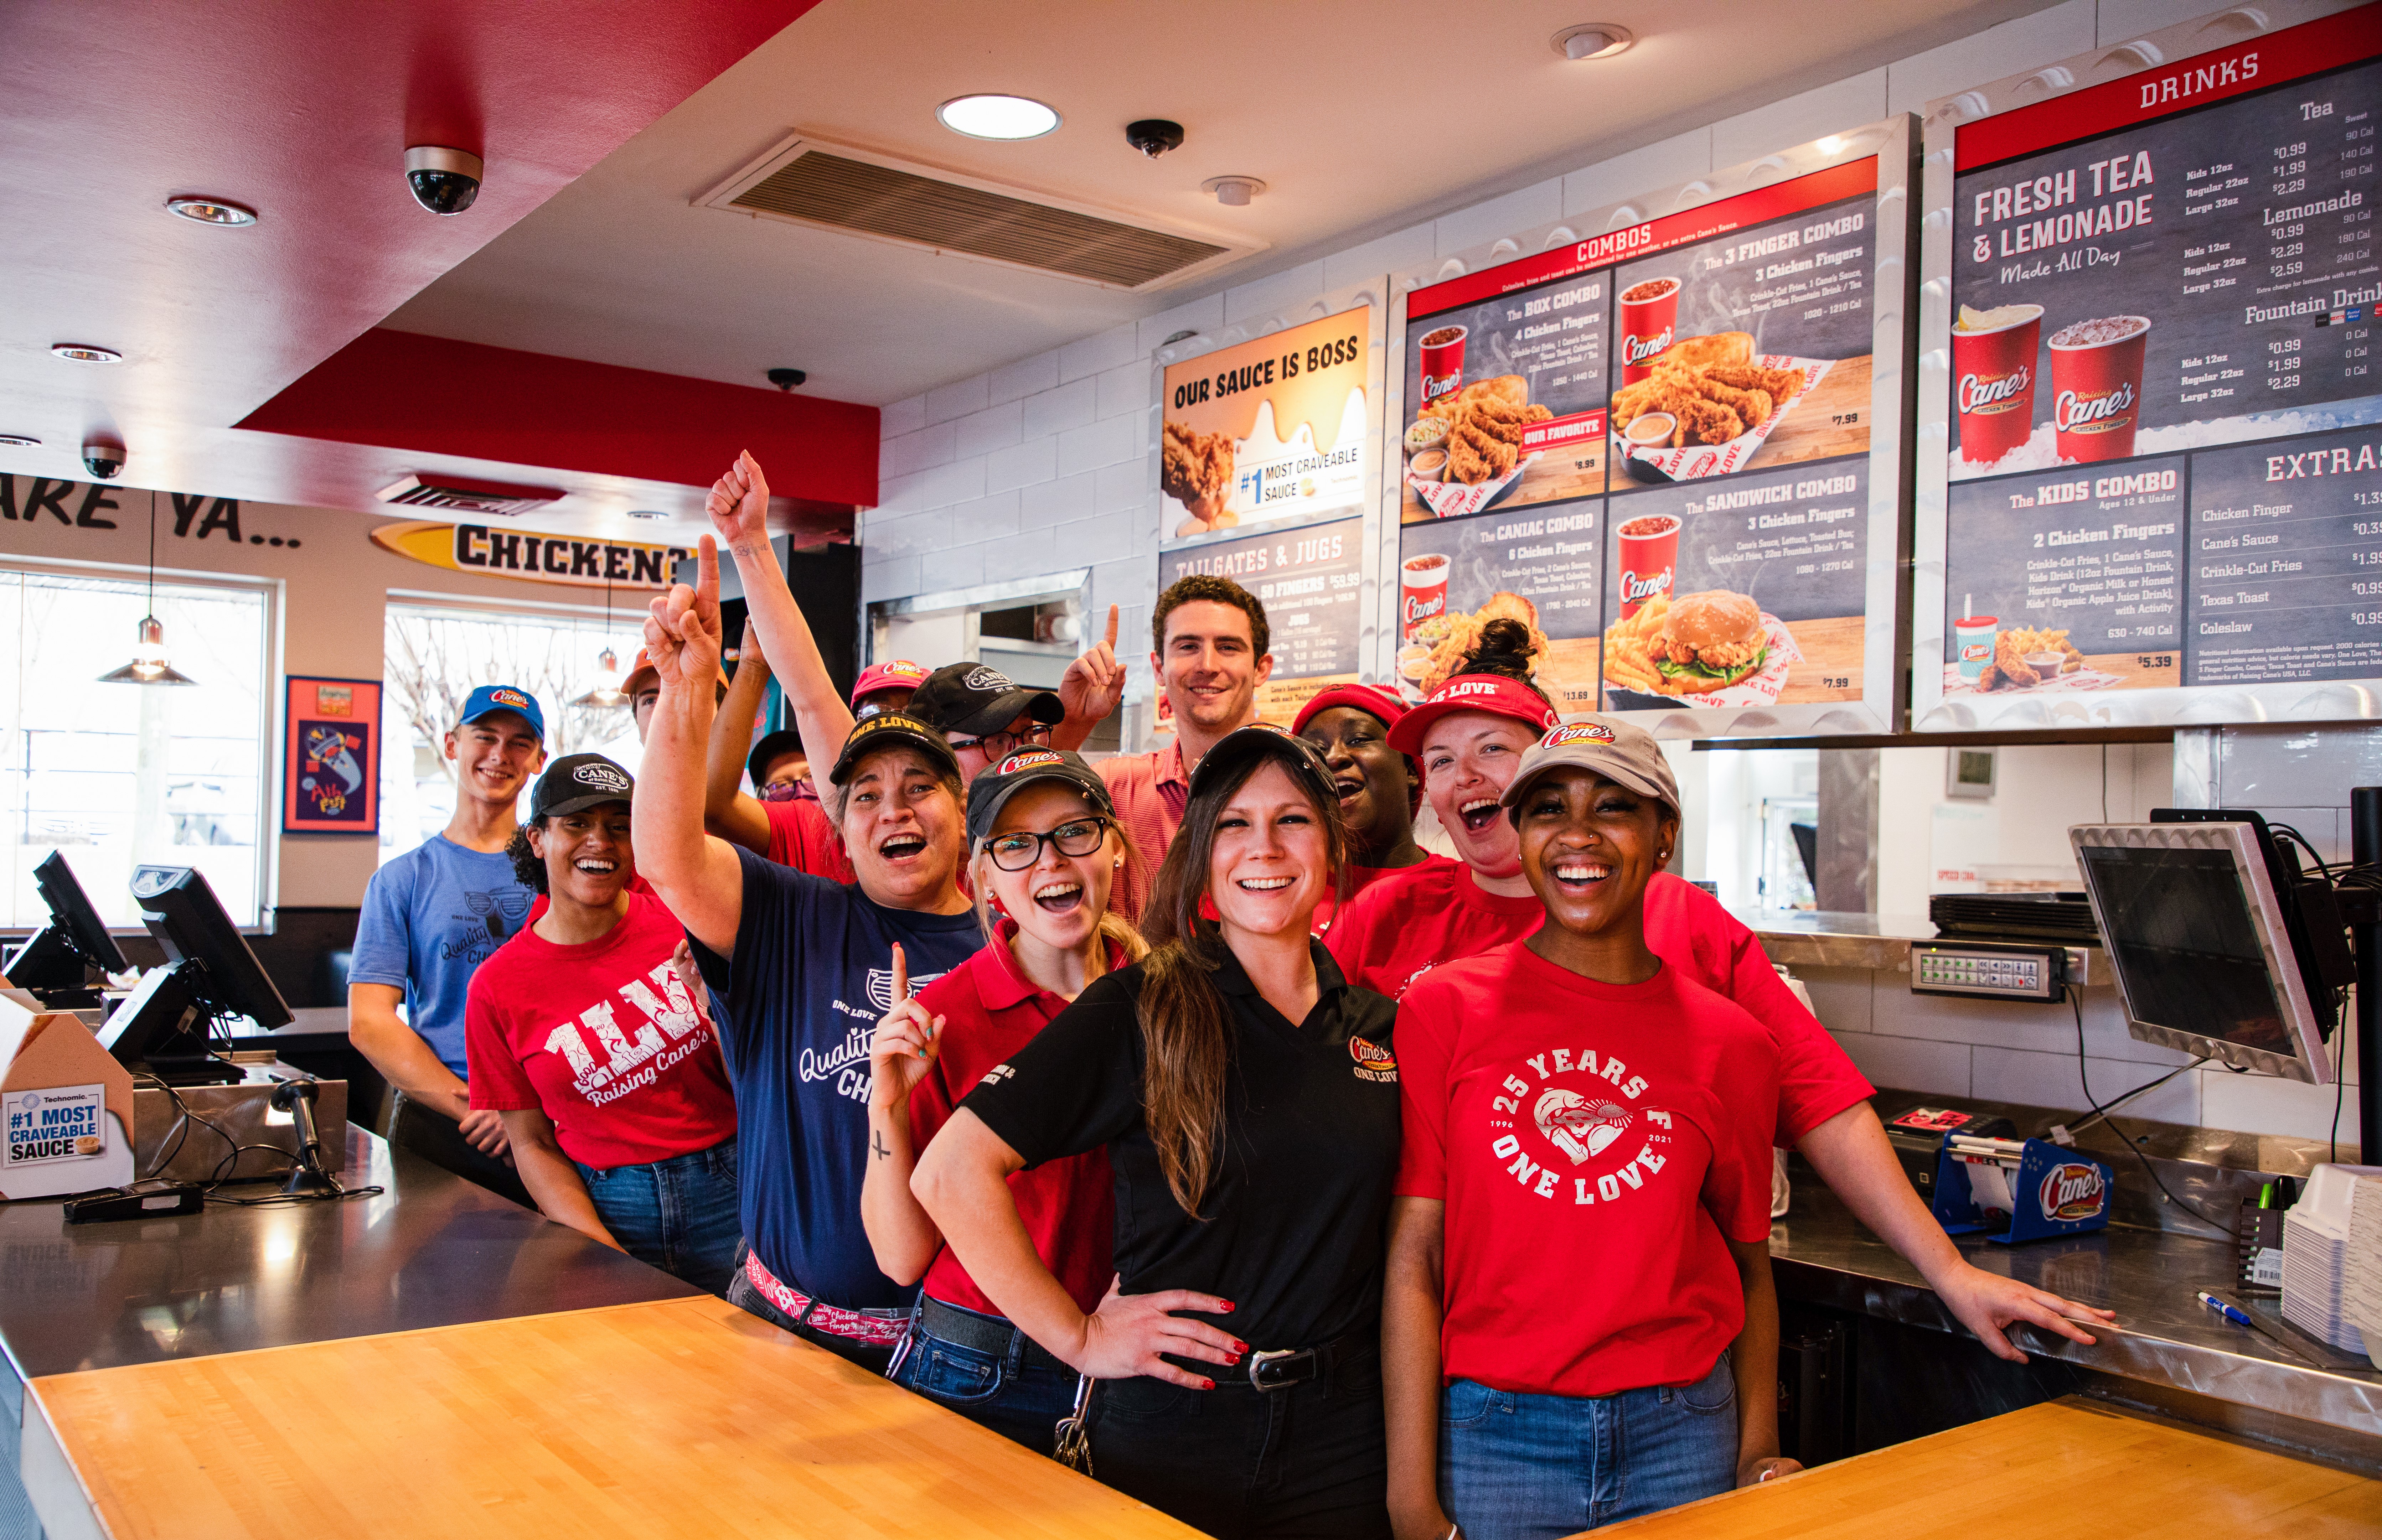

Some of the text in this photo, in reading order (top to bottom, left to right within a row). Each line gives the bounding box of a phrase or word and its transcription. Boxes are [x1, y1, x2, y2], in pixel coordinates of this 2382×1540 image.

[2140, 52, 2258, 108] DRINKS
[2300, 102, 2334, 121] Tea
[2345, 112, 2367, 123] Sweet
[2274, 142, 2307, 159] $0.99
[2186, 161, 2306, 181] Kids 12oz $1.99
[1975, 150, 2154, 226] FRESH TEA
[2186, 177, 2305, 198] Regular 22oz $2.29
[2186, 197, 2238, 216] Large 32oz
[2263, 190, 2362, 226] Lemonade
[1973, 194, 2153, 263] & LEMONADE
[2272, 224, 2304, 240] $0.99
[1577, 224, 1651, 262] COMBOS
[1704, 213, 1864, 270] The 3 FINGER COMBO
[2184, 242, 2304, 259] Kids 12oz $2.29
[1756, 246, 1863, 282] 3 Chicken Fingers
[2001, 247, 2120, 284] Made All Day
[2183, 257, 2303, 278] Regular 22oz $2.59
[2183, 277, 2236, 295] Large 32oz
[2303, 275, 2330, 285] lemonade
[1507, 284, 1600, 321] The BOX COMBO
[2245, 297, 2326, 325] Fountain
[1515, 313, 1600, 341] 4 Chicken Fingers
[1623, 326, 1673, 366] Cane's
[2268, 339, 2301, 354] $0.99
[1175, 336, 1358, 409] OUR SAUCE IS BOSS
[2268, 357, 2301, 372] $1.99
[1422, 368, 1461, 402] Cane's
[1959, 365, 2030, 414] Cane's
[2268, 375, 2300, 390] $2.29
[2055, 382, 2135, 432] Cane's
[1832, 413, 1858, 426] $7.99
[1524, 420, 1599, 445] OUR FAVORITE
[1265, 447, 1357, 481] MOST CRAVEABLE
[1576, 459, 1595, 470] $8.99
[1241, 469, 1262, 504] #1
[1265, 482, 1296, 501] SAUCE
[1686, 475, 1857, 515] The SANDWICH COMBO
[2010, 470, 2176, 509] The KIDS COMBO
[2098, 500, 2121, 511] Ages
[2123, 498, 2134, 506] 12
[2149, 493, 2176, 503] Under
[2202, 503, 2293, 522] Chicken Finger
[171, 492, 300, 548] YA...
[1481, 513, 1593, 543] The CANIAC COMBO
[1748, 507, 1855, 530] 3 Chicken Fingers
[2034, 522, 2175, 548] 2 Chicken Fingers
[2202, 534, 2279, 550] Cane's Sauce
[456, 524, 688, 584] CHICKEN?
[1177, 535, 1343, 578] TAILGATES & JUGS
[1509, 541, 1592, 560] 6 Chicken Fingers
[2201, 560, 2302, 579] Crinkle-Cut Fries
[1261, 584, 1274, 599] 50
[1276, 576, 1325, 597] FINGERS
[1620, 566, 1671, 604] Cane's
[2200, 592, 2269, 607] Texas Toast
[2200, 622, 2252, 635] Coleslaw
[2138, 656, 2172, 667] $5.39
[1428, 682, 1495, 704] NE LOVE
[1823, 678, 1848, 688] $7.99
[849, 717, 924, 745] ONE LOVE
[1544, 725, 1614, 749] Cane's
[1000, 752, 1063, 775] Cane's
[578, 769, 626, 785] CANE'S
[441, 928, 491, 960] Quality
[833, 999, 875, 1021] ONE LOVE
[800, 1027, 877, 1083] Qualit
[1350, 1035, 1391, 1063] Cane's
[587, 1030, 709, 1107] Raising Cane's
[1354, 1067, 1397, 1082] ONE LOV
[43, 1094, 87, 1103] Technomic.
[1492, 1048, 1672, 1129] 25 YEARS F
[10, 1105, 97, 1129] #1 MOST
[1490, 1120, 1513, 1128] 1996
[10, 1122, 97, 1143] CRAVEABLE
[1648, 1134, 1671, 1143] 2021
[11, 1139, 74, 1160] SAUCE
[1492, 1134, 1667, 1204] ONE LOVE
[2043, 1164, 2103, 1217] Cane's
